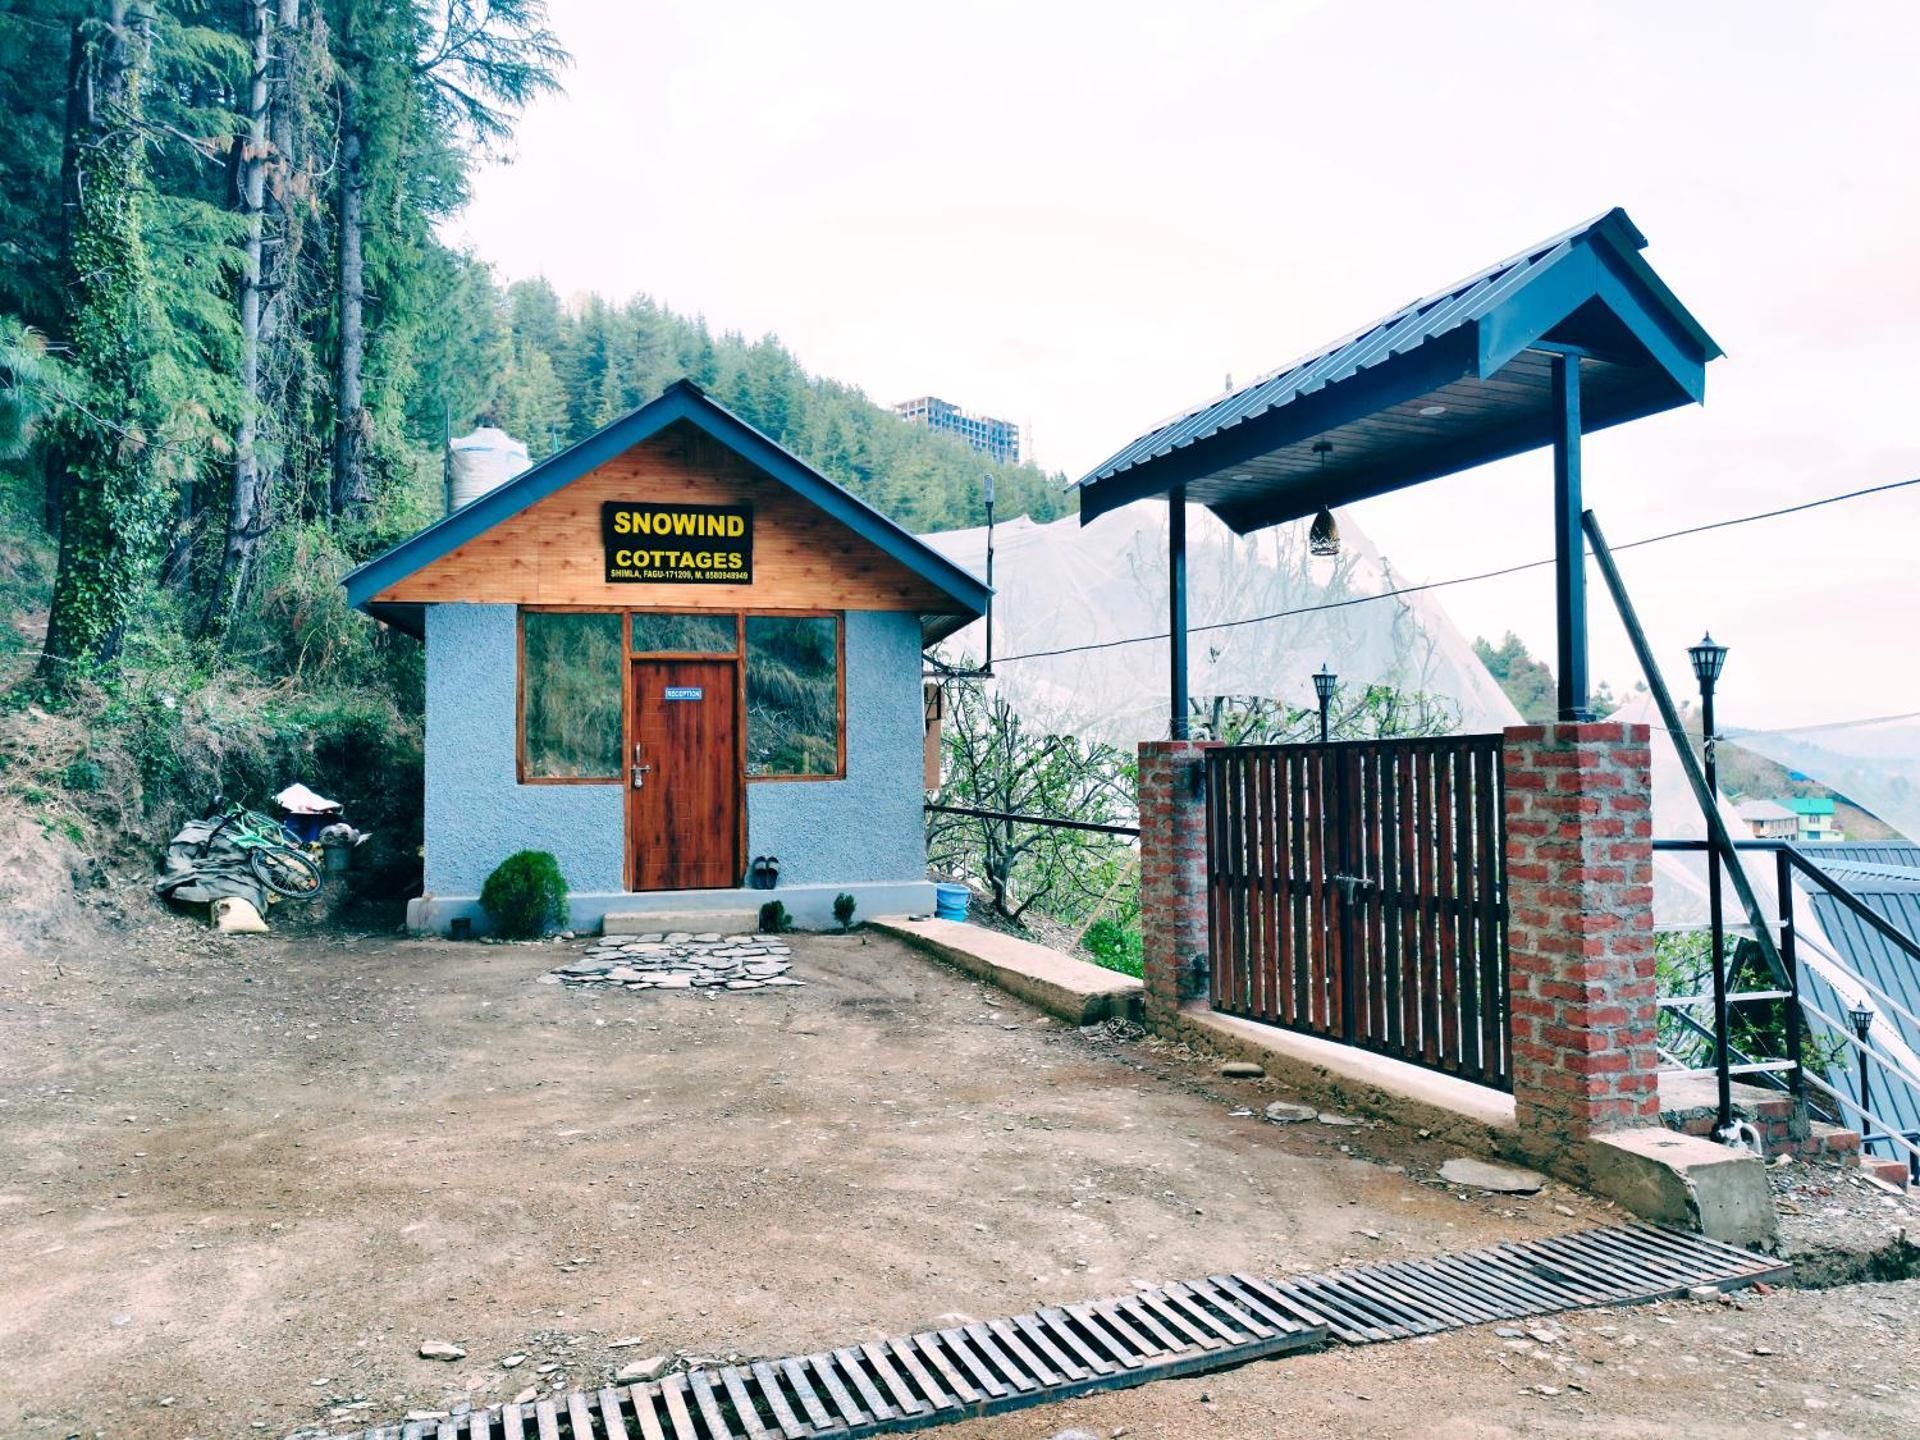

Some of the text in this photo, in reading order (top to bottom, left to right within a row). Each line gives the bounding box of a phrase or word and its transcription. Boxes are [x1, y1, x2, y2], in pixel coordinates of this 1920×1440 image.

[613, 511, 745, 537] SNOWIND
[615, 549, 743, 569] COTTAGES
[610, 569, 642, 579] SHIMLA,
